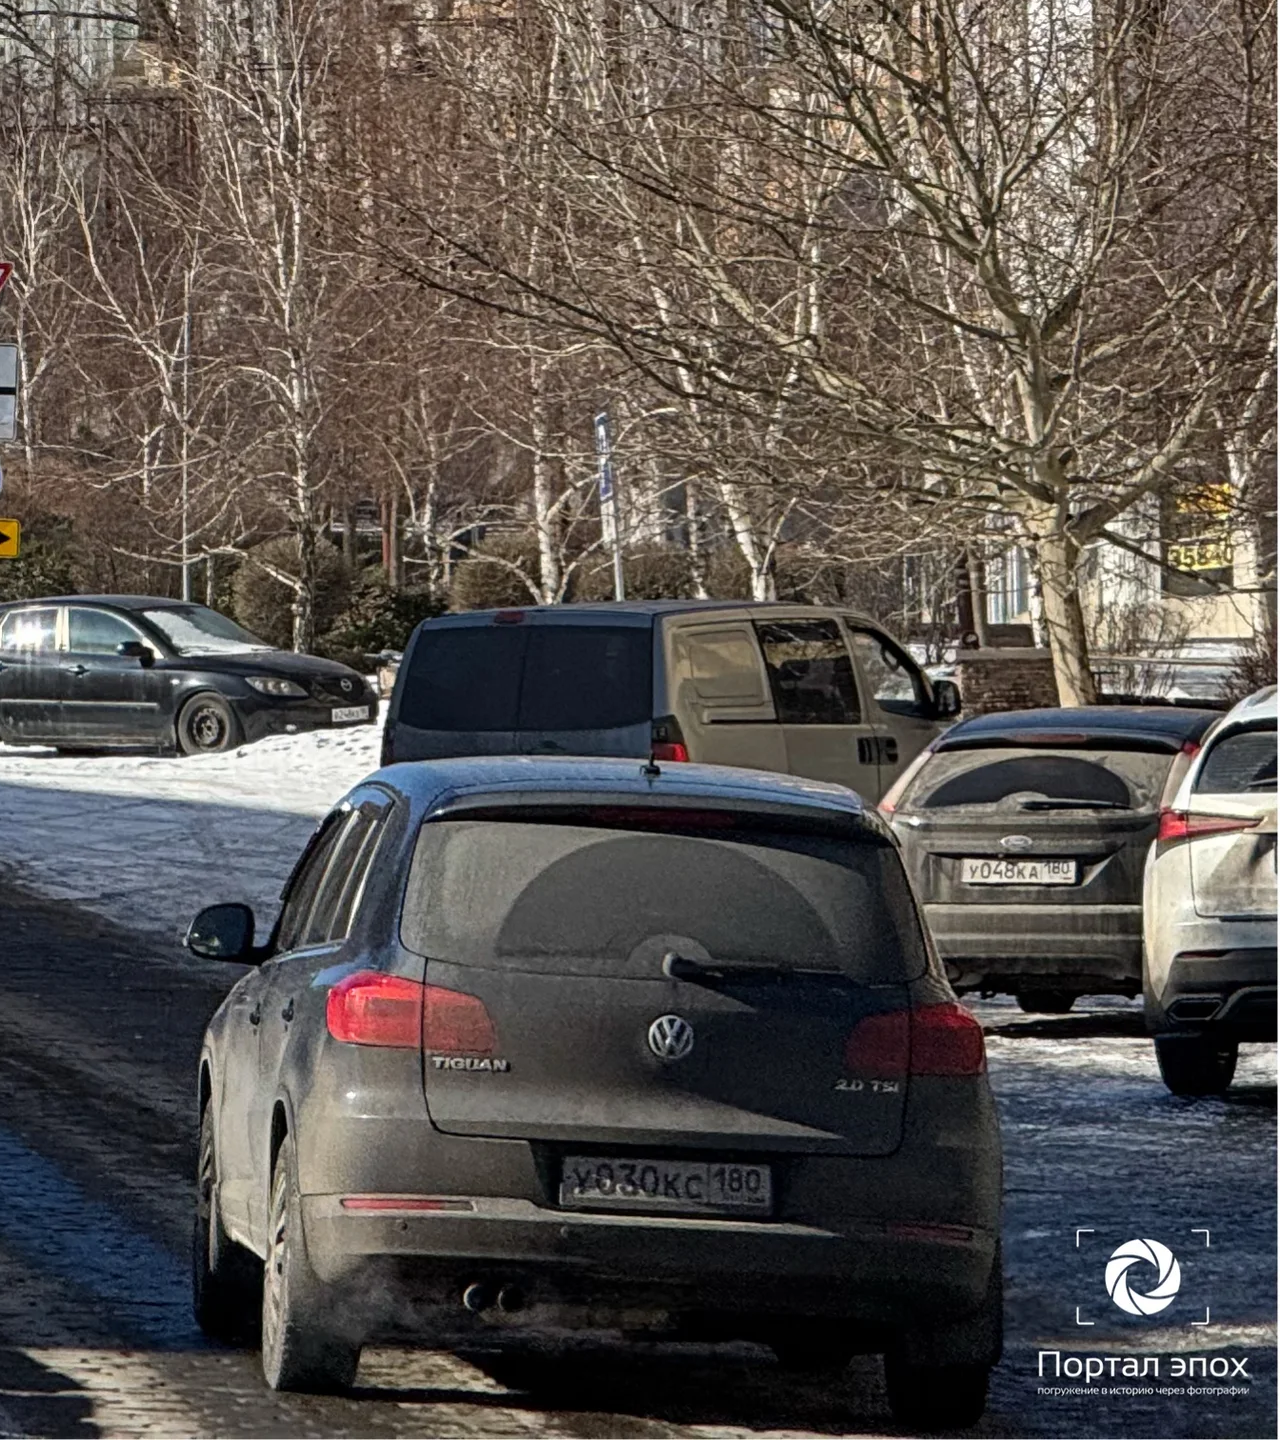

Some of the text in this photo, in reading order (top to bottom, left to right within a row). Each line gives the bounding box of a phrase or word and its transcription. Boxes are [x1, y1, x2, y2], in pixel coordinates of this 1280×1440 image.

[969, 861, 1072, 880] У048КА 180
[432, 1056, 508, 1071] TIGUAN
[870, 1080, 899, 1093] TSI
[713, 1166, 761, 1194] 180
